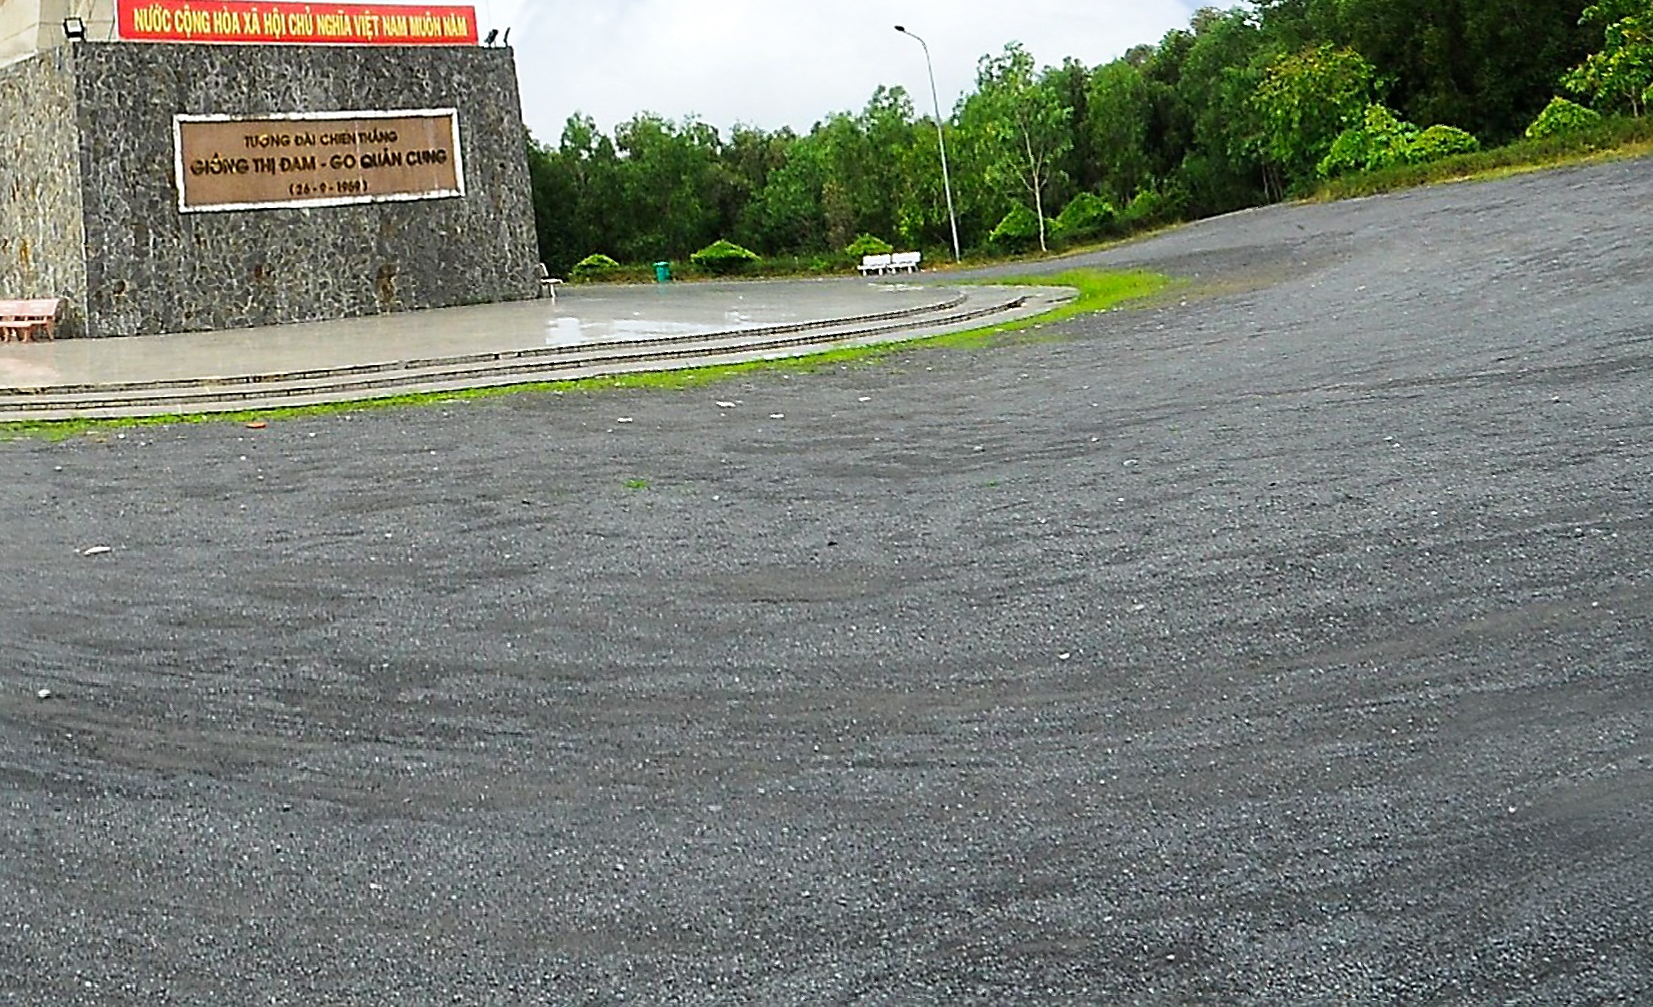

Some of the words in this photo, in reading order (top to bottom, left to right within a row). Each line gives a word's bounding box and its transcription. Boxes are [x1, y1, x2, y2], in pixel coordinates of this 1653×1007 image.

[134, 3, 172, 32] NƯỚC
[174, 4, 211, 38] CỘNG
[213, 5, 241, 34] HÒA
[243, 7, 261, 35] XÃ
[263, 7, 286, 39] HỘI
[288, 5, 313, 36] CHỦ
[316, 9, 352, 36] NGHĨA
[353, 10, 380, 41] VIỆT
[382, 15, 408, 36] NAM
[409, 11, 442, 36] MUÔN
[443, 13, 468, 36] NĂM
[252, 157, 276, 175] THỊ
[406, 149, 447, 166] CUNG
